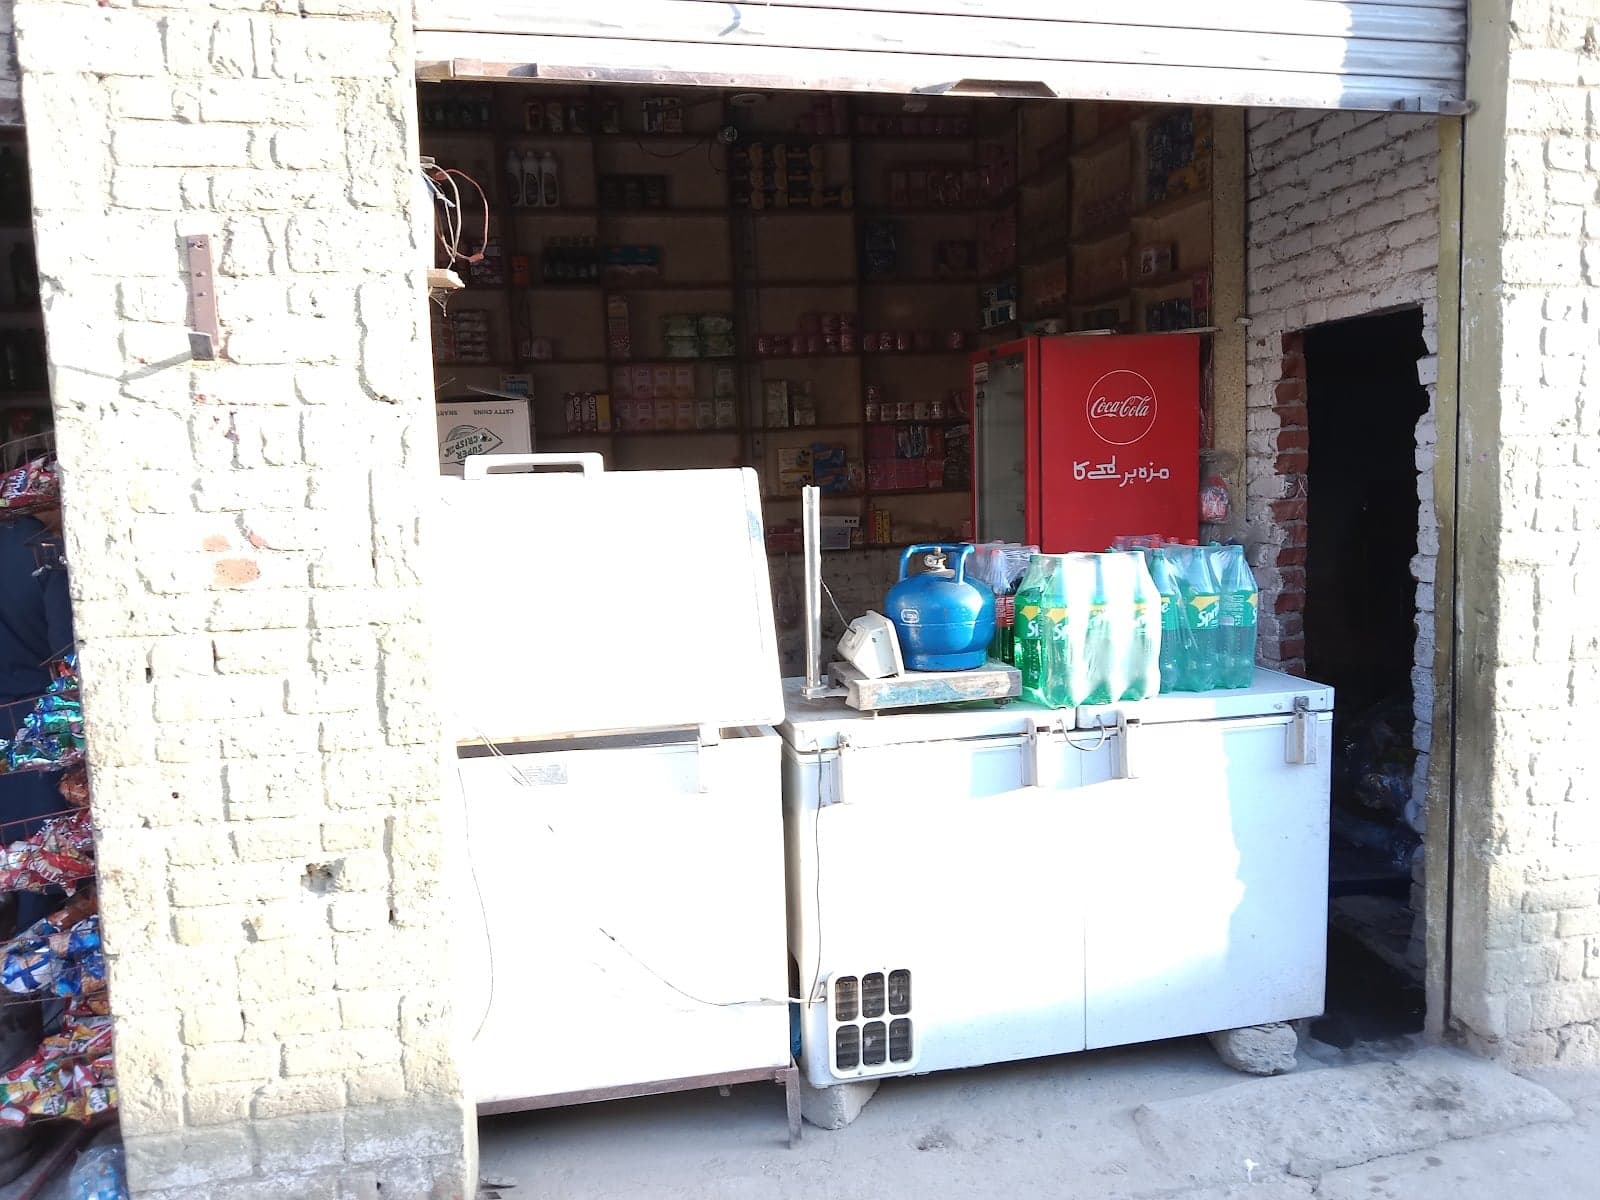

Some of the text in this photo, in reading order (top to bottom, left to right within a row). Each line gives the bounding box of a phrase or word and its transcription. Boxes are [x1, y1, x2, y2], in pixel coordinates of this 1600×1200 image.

[455, 435, 478, 449] CRISP
[456, 444, 482, 460] SUPER
[1074, 461, 1090, 480] کا
